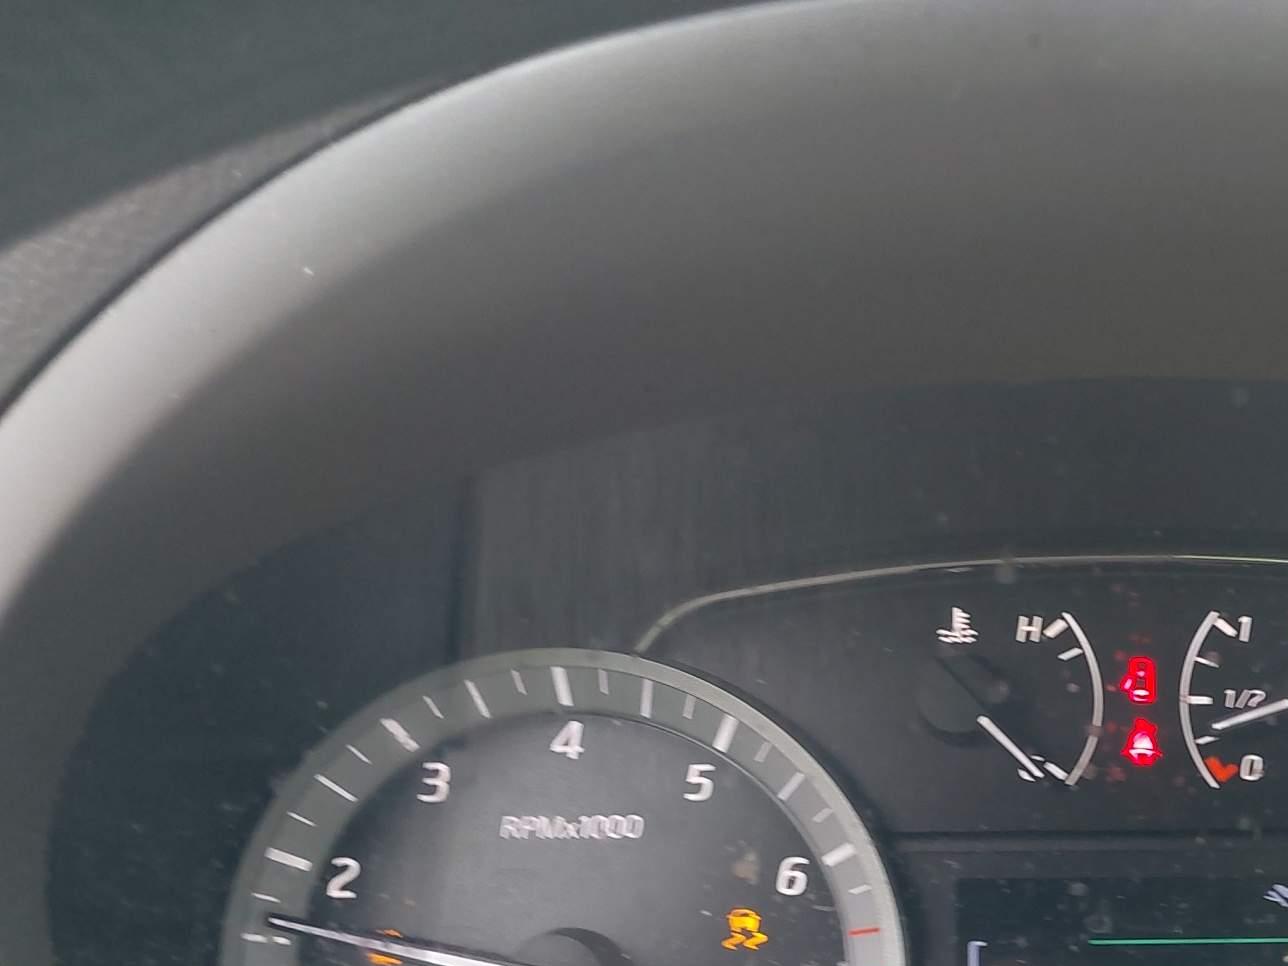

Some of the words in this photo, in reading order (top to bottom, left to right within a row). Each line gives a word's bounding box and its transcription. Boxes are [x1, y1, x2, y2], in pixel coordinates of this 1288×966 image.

[1016, 615, 1043, 643] H
[1237, 616, 1252, 643] 1
[550, 721, 584, 759] 4
[417, 761, 451, 802] 3
[684, 763, 716, 802] 5
[1239, 754, 1265, 781] 0
[326, 857, 361, 899] 2
[775, 856, 810, 896] 6
